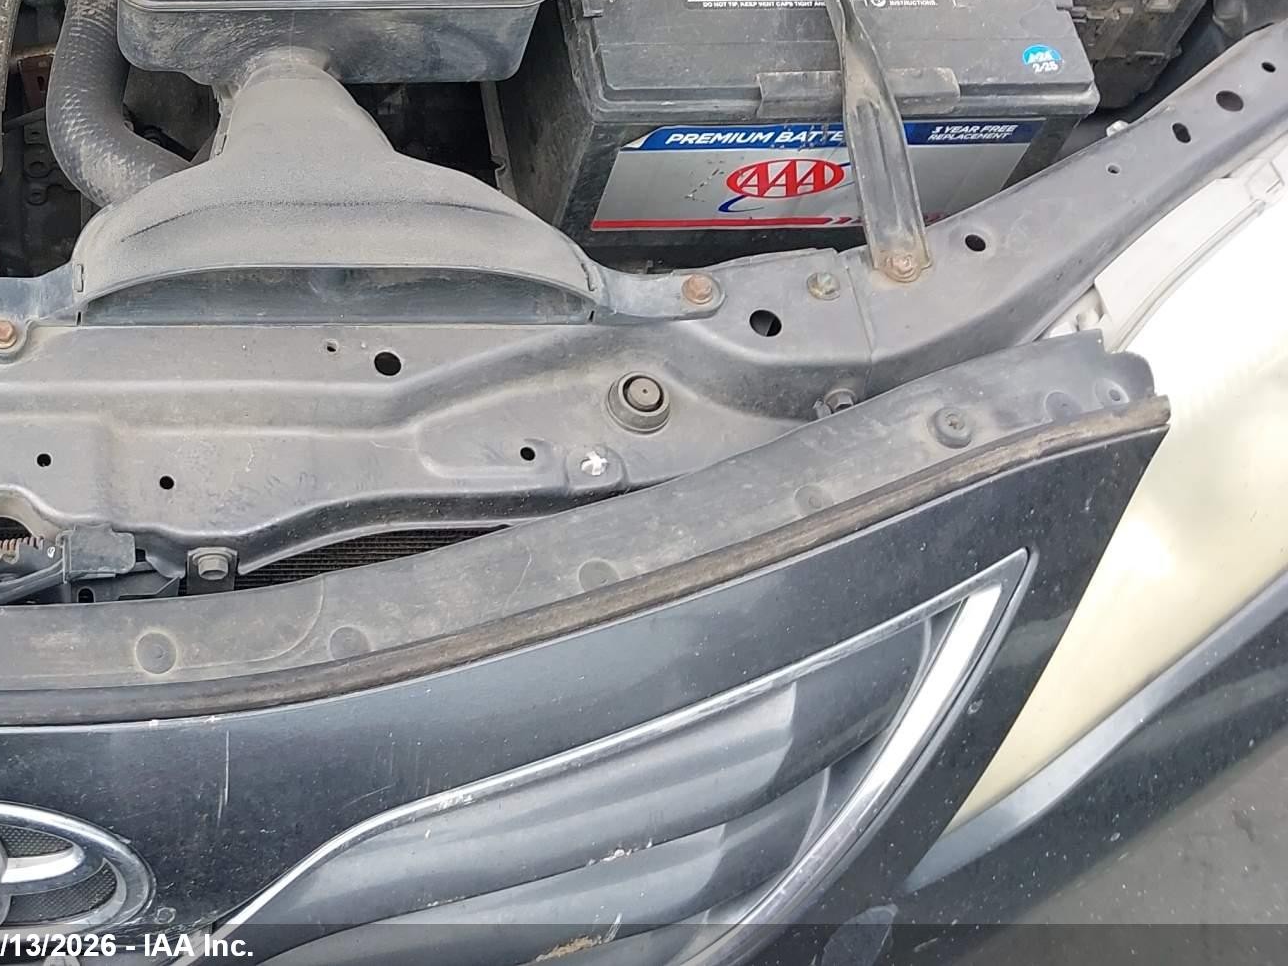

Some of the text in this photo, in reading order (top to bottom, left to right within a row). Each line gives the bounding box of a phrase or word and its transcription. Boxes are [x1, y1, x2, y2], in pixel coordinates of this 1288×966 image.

[931, 124, 1018, 134] 3 YEAR FREE
[665, 130, 844, 145] PREMIUM BATTE
[927, 132, 1011, 141] REPLACEMENT
[736, 159, 831, 198] AAA
